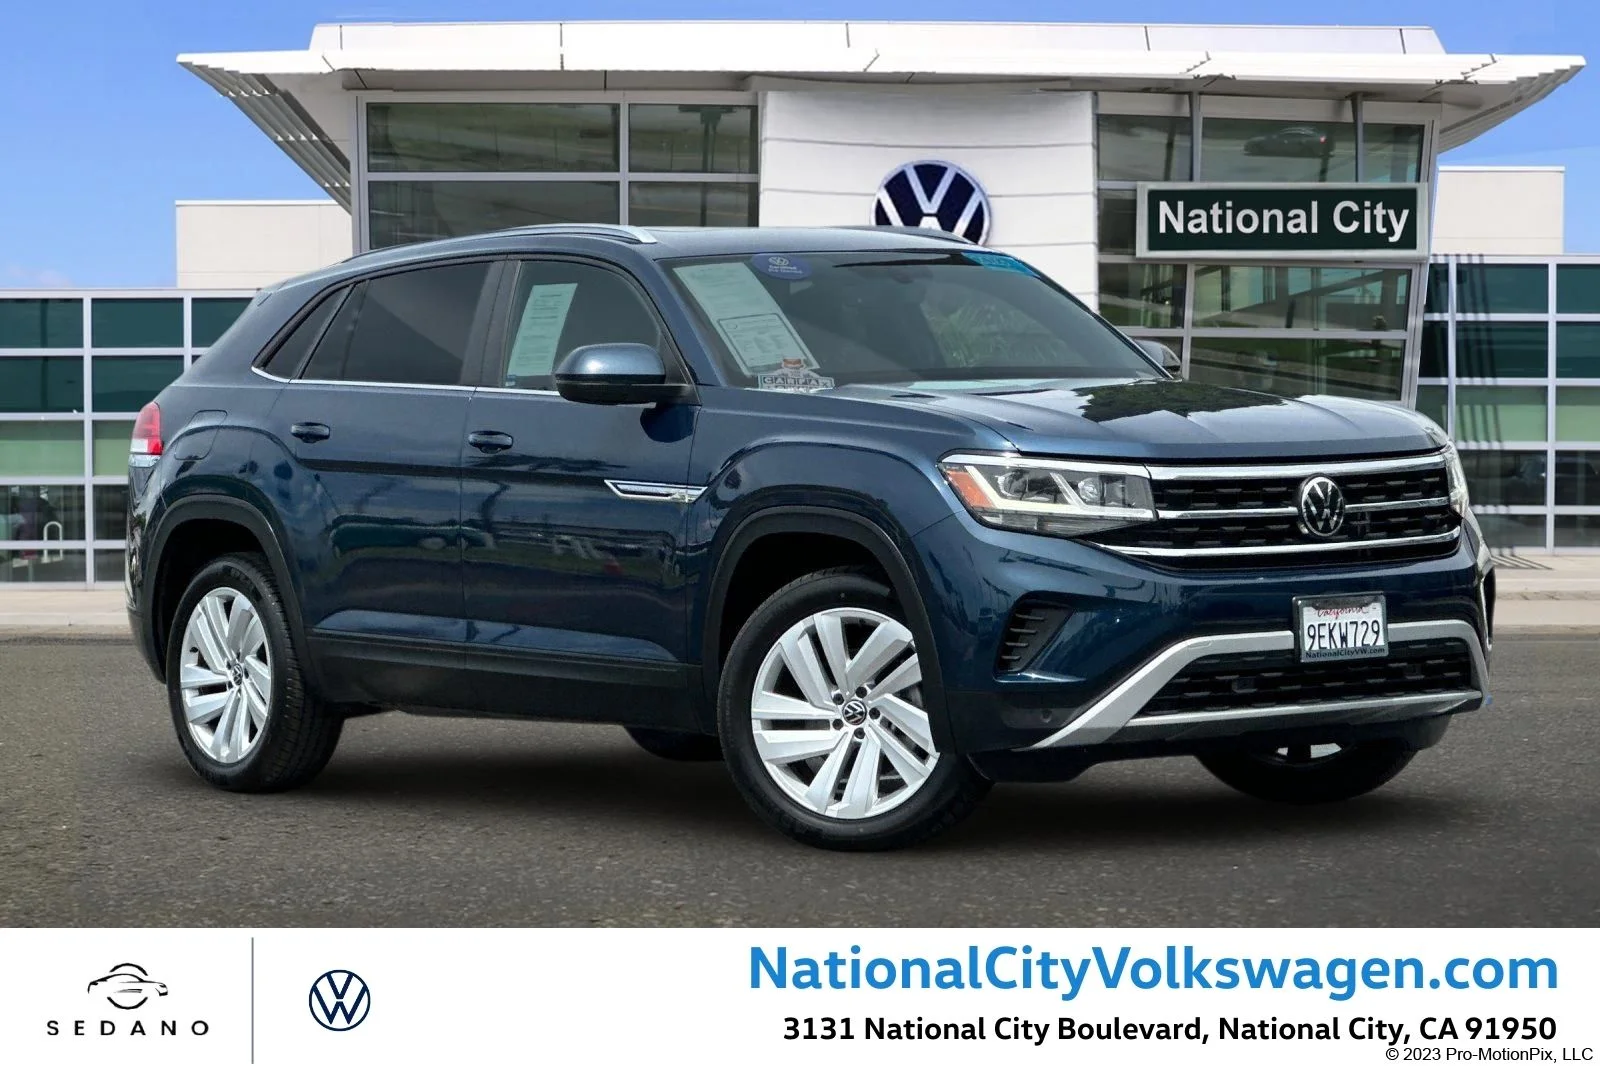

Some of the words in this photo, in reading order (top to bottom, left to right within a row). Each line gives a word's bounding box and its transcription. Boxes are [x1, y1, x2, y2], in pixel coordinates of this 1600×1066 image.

[1158, 201, 1318, 235] National
[1333, 200, 1410, 243] City
[1307, 619, 1381, 651] 9EKW729
[1305, 647, 1386, 660] NationalCityVW.com
